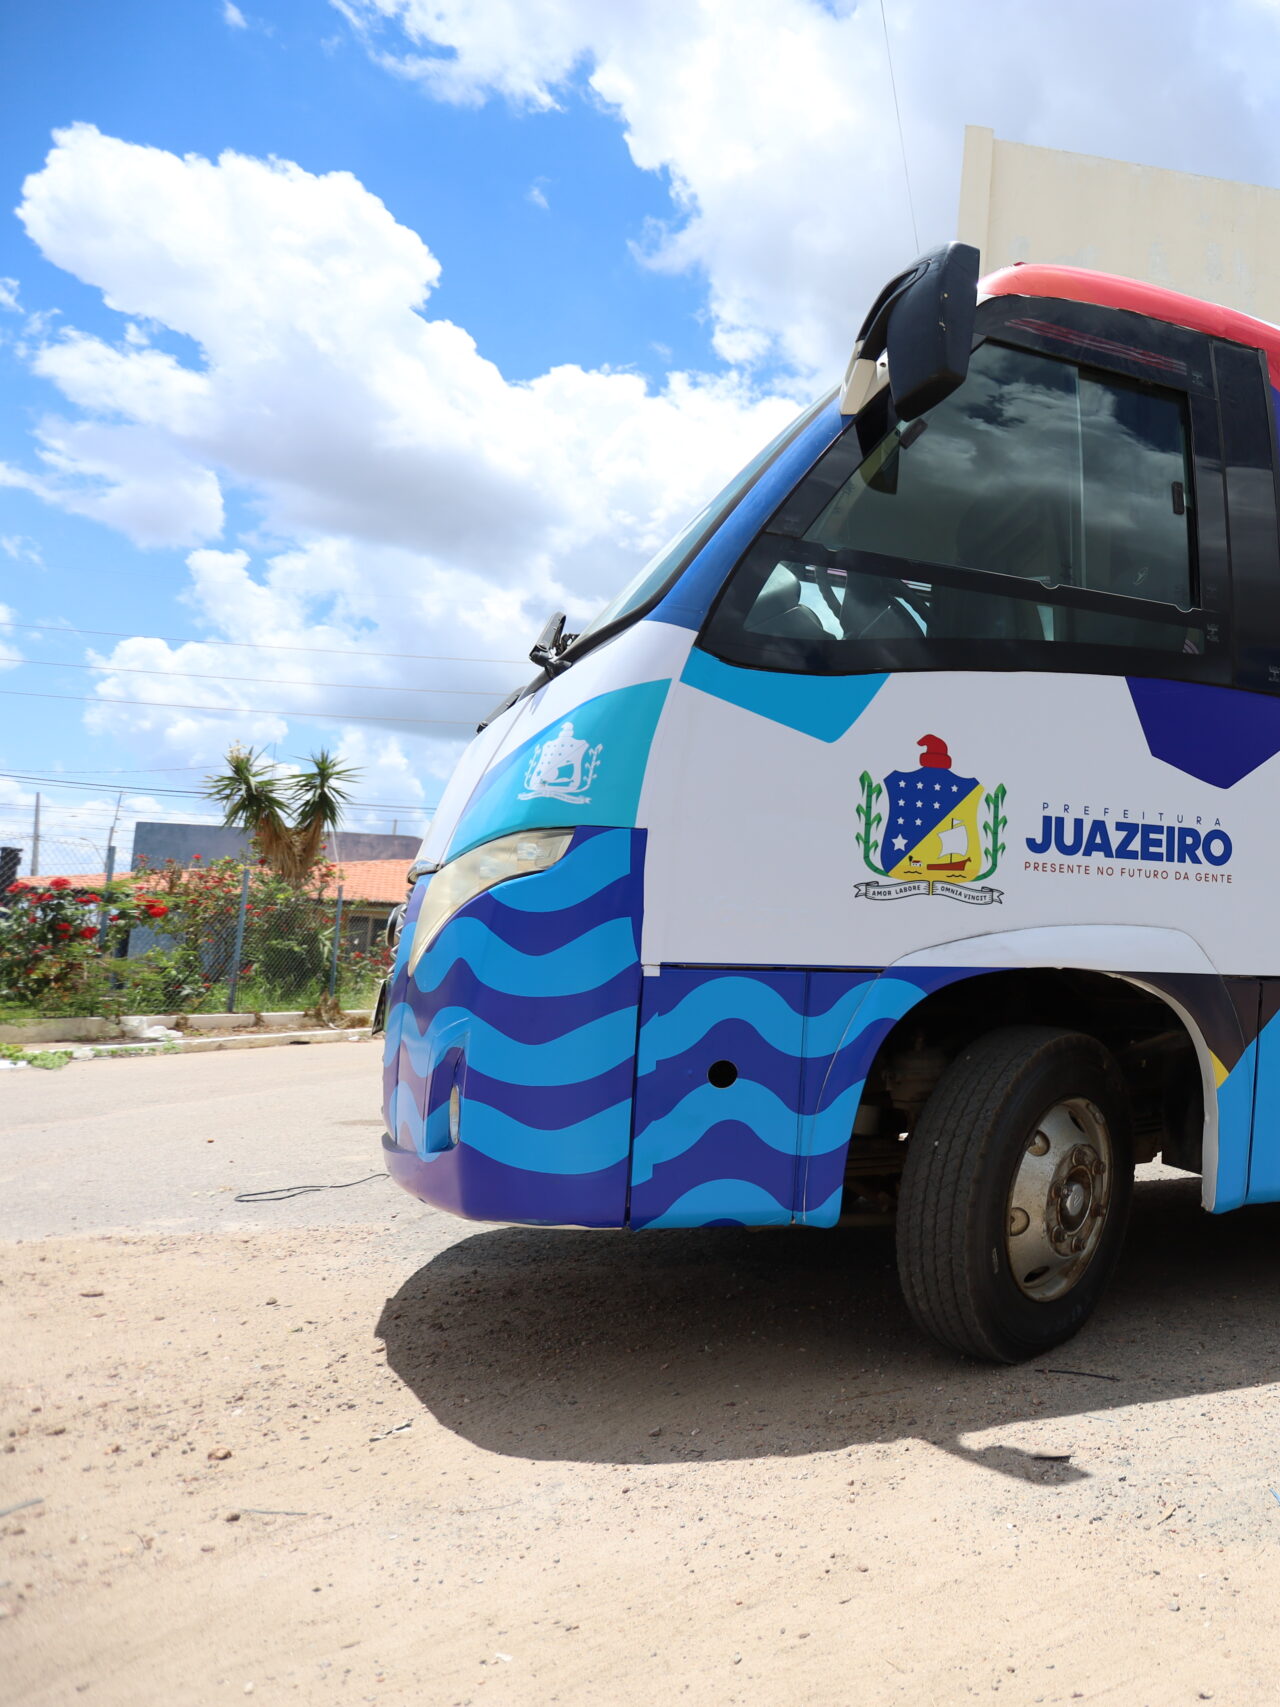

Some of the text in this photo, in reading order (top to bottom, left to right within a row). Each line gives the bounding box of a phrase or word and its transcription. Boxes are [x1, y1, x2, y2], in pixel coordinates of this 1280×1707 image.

[1042, 802, 1221, 826] PREFEITURA
[1025, 815, 1233, 867] JUAZEIRO
[1024, 861, 1233, 884] PRESENTE NO FUTURO DA GENTE
[895, 884, 921, 895] LABORE
[940, 885, 987, 901] OMNIA VINCIT
